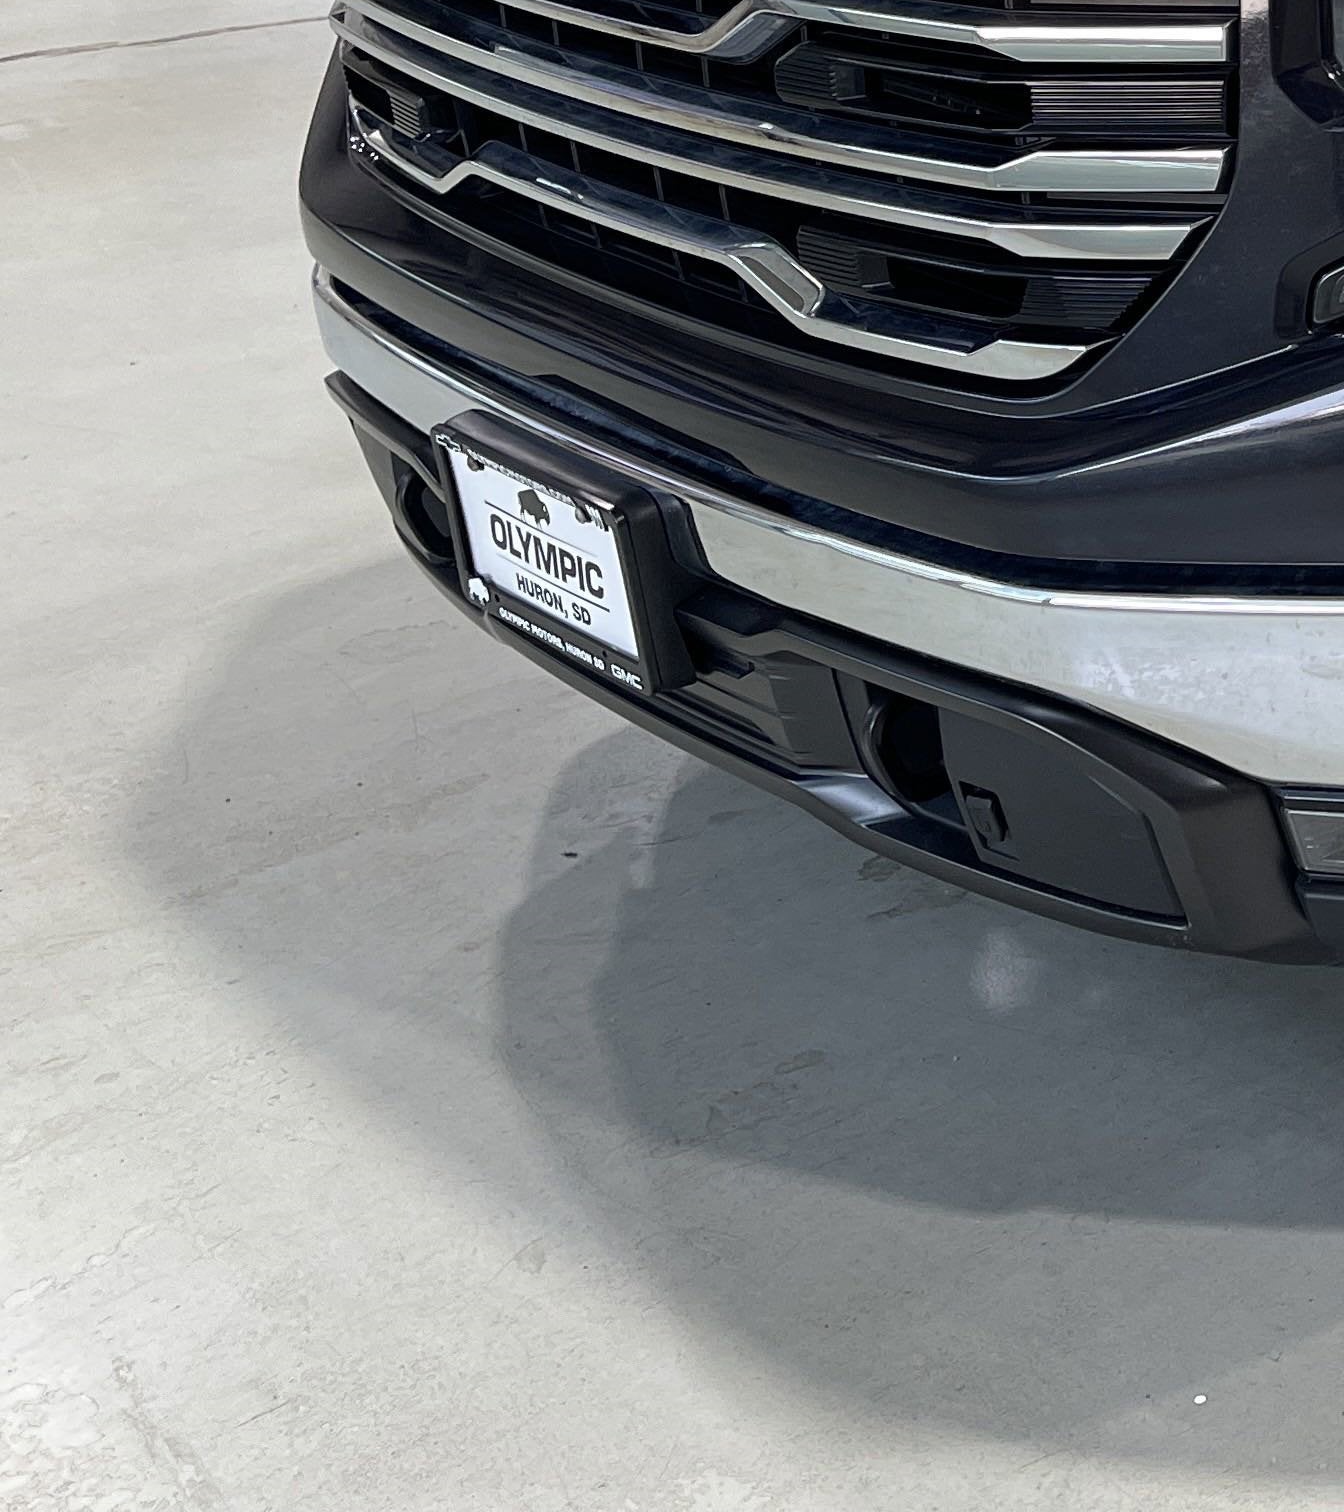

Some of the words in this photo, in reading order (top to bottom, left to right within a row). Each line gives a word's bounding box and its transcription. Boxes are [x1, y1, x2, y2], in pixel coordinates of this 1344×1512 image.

[490, 513, 605, 600] OLYMPIC
[516, 572, 569, 619] HURON,
[572, 602, 592, 627] SD
[610, 663, 644, 691] GMC
